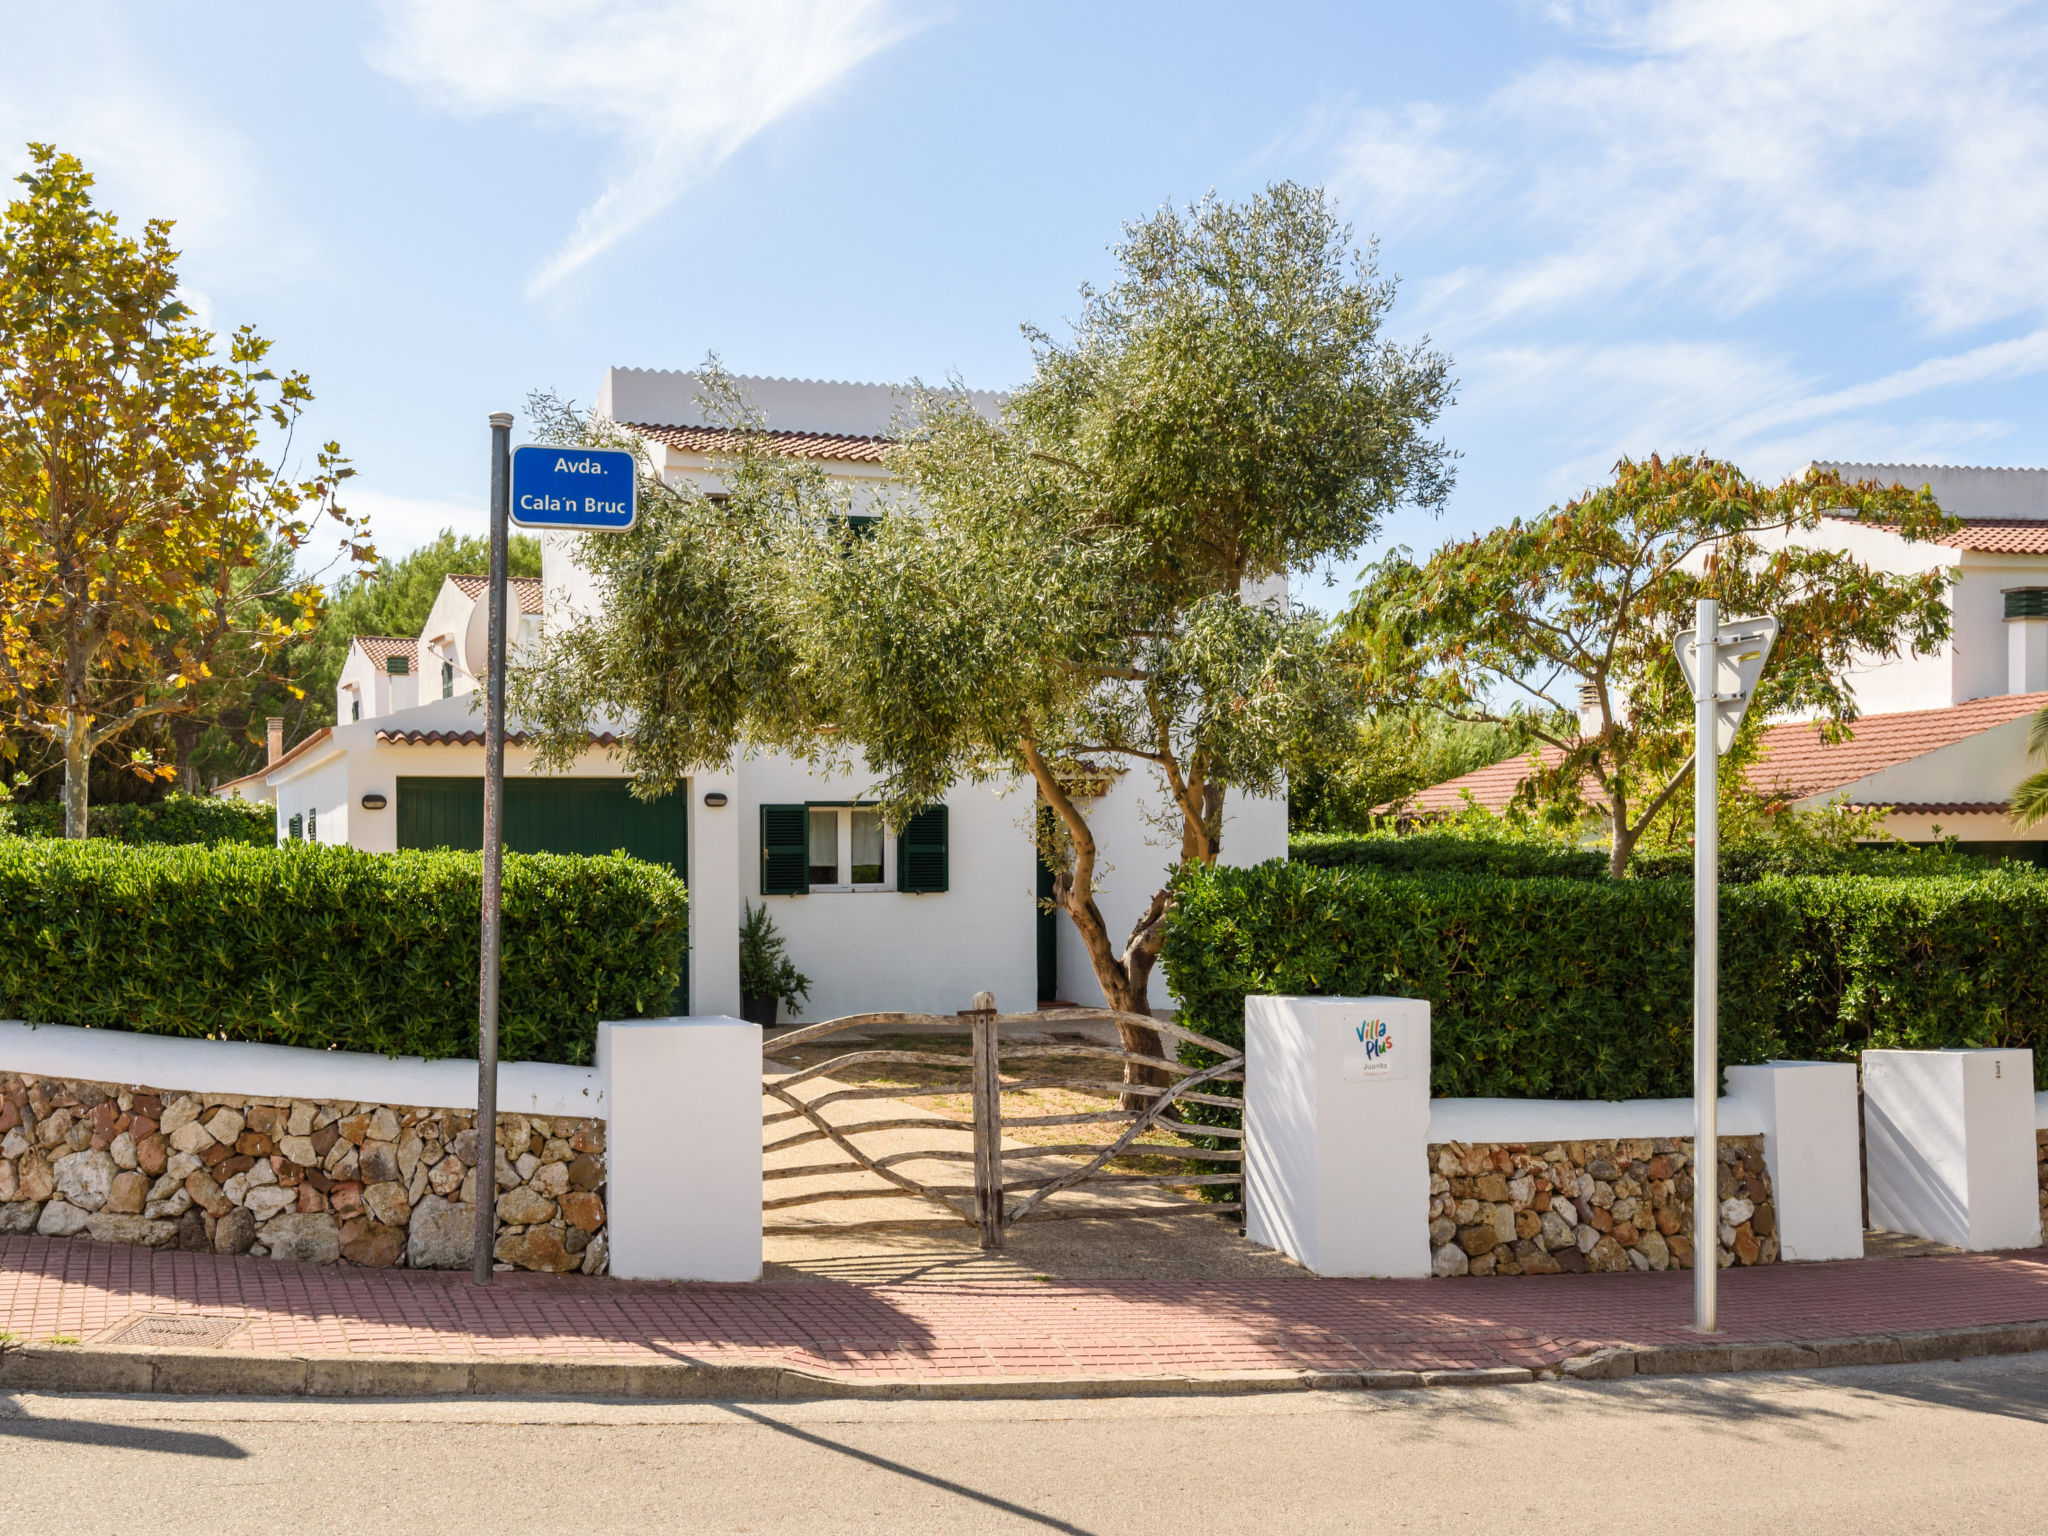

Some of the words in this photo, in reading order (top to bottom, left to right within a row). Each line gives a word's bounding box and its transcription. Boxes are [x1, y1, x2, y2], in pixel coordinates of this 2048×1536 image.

[554, 457, 608, 475] Avda.
[585, 497, 626, 514] Bruc
[1356, 1019, 1386, 1042] Villa
